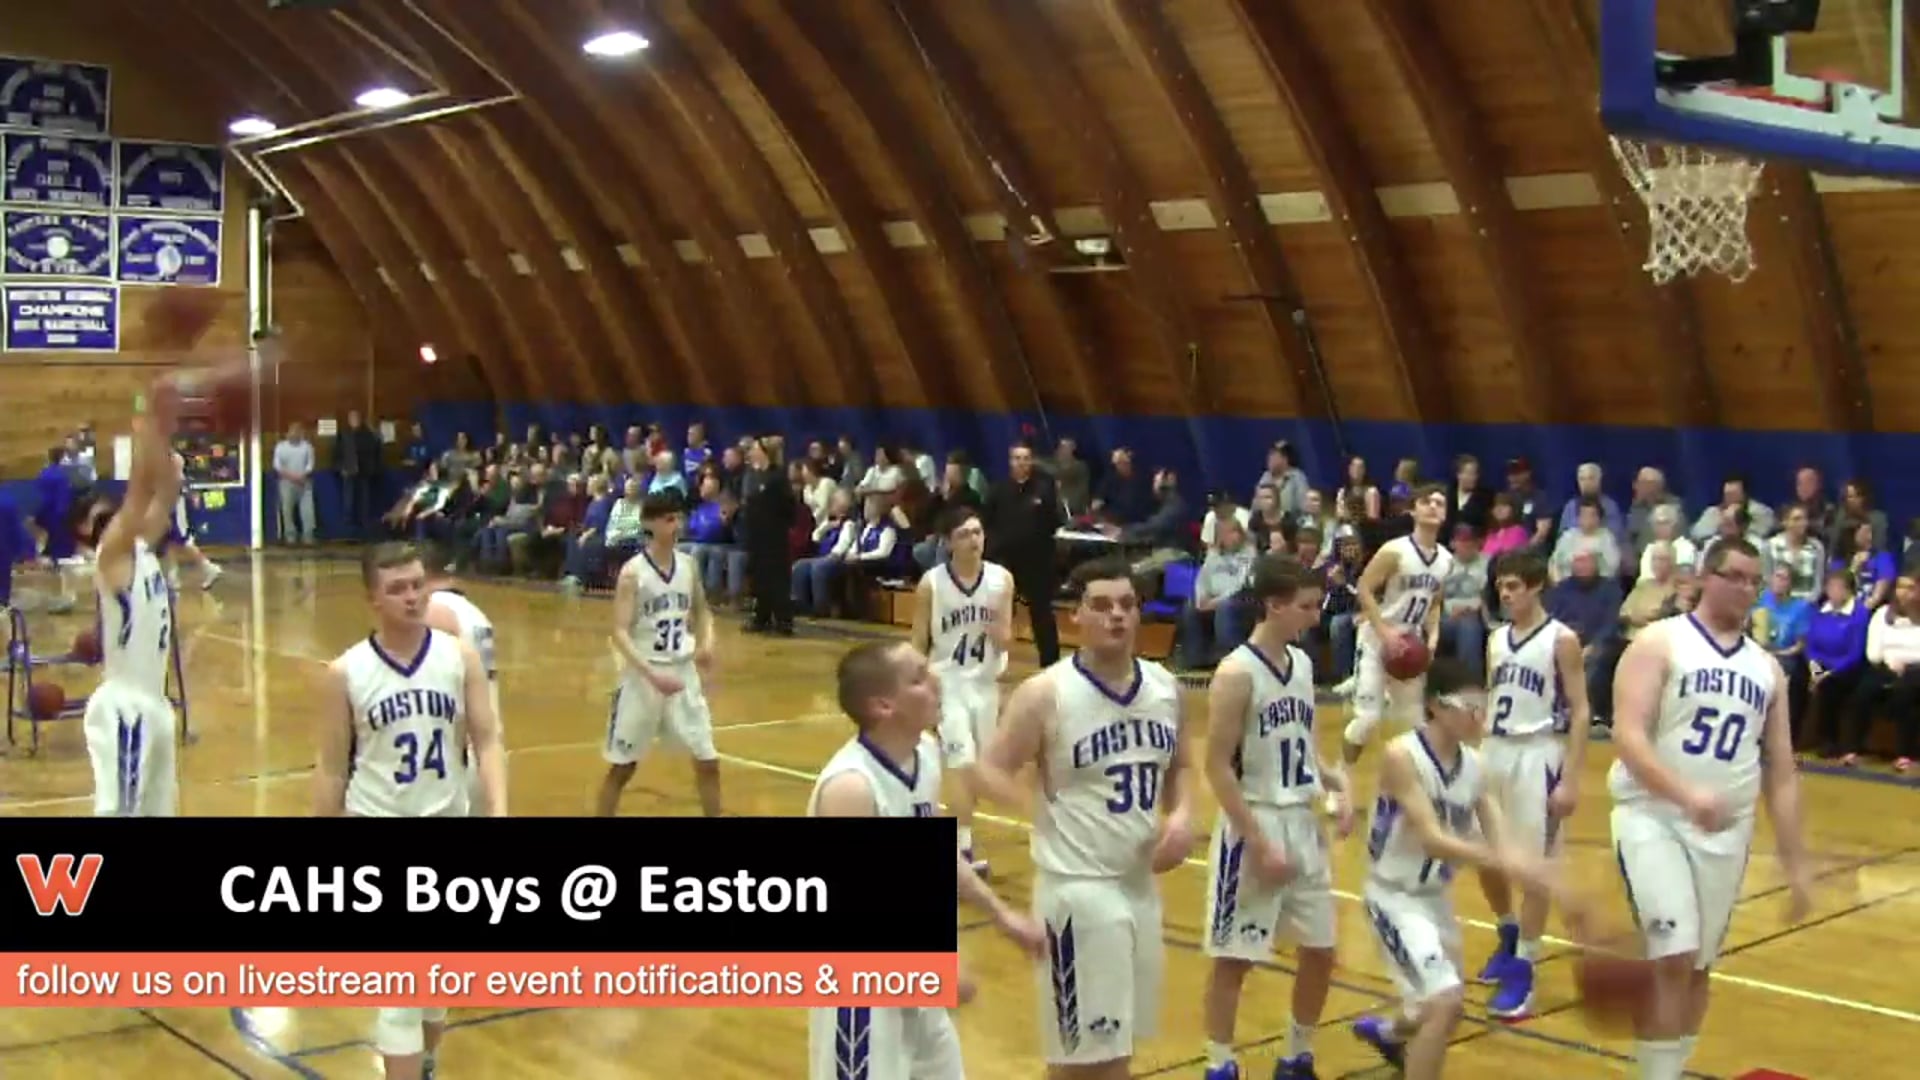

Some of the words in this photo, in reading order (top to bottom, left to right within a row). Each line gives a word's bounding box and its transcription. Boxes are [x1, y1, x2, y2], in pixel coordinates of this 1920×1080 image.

[653, 618, 683, 652] 32
[953, 632, 987, 667] 44
[367, 688, 457, 732] EASTON
[1678, 666, 1766, 716] EASTON
[1258, 695, 1314, 739] EASTON
[1682, 706, 1747, 762] 50
[393, 727, 446, 785] 34
[1073, 717, 1176, 769] EASTON
[1280, 736, 1315, 789] 12
[1103, 761, 1159, 814] 30
